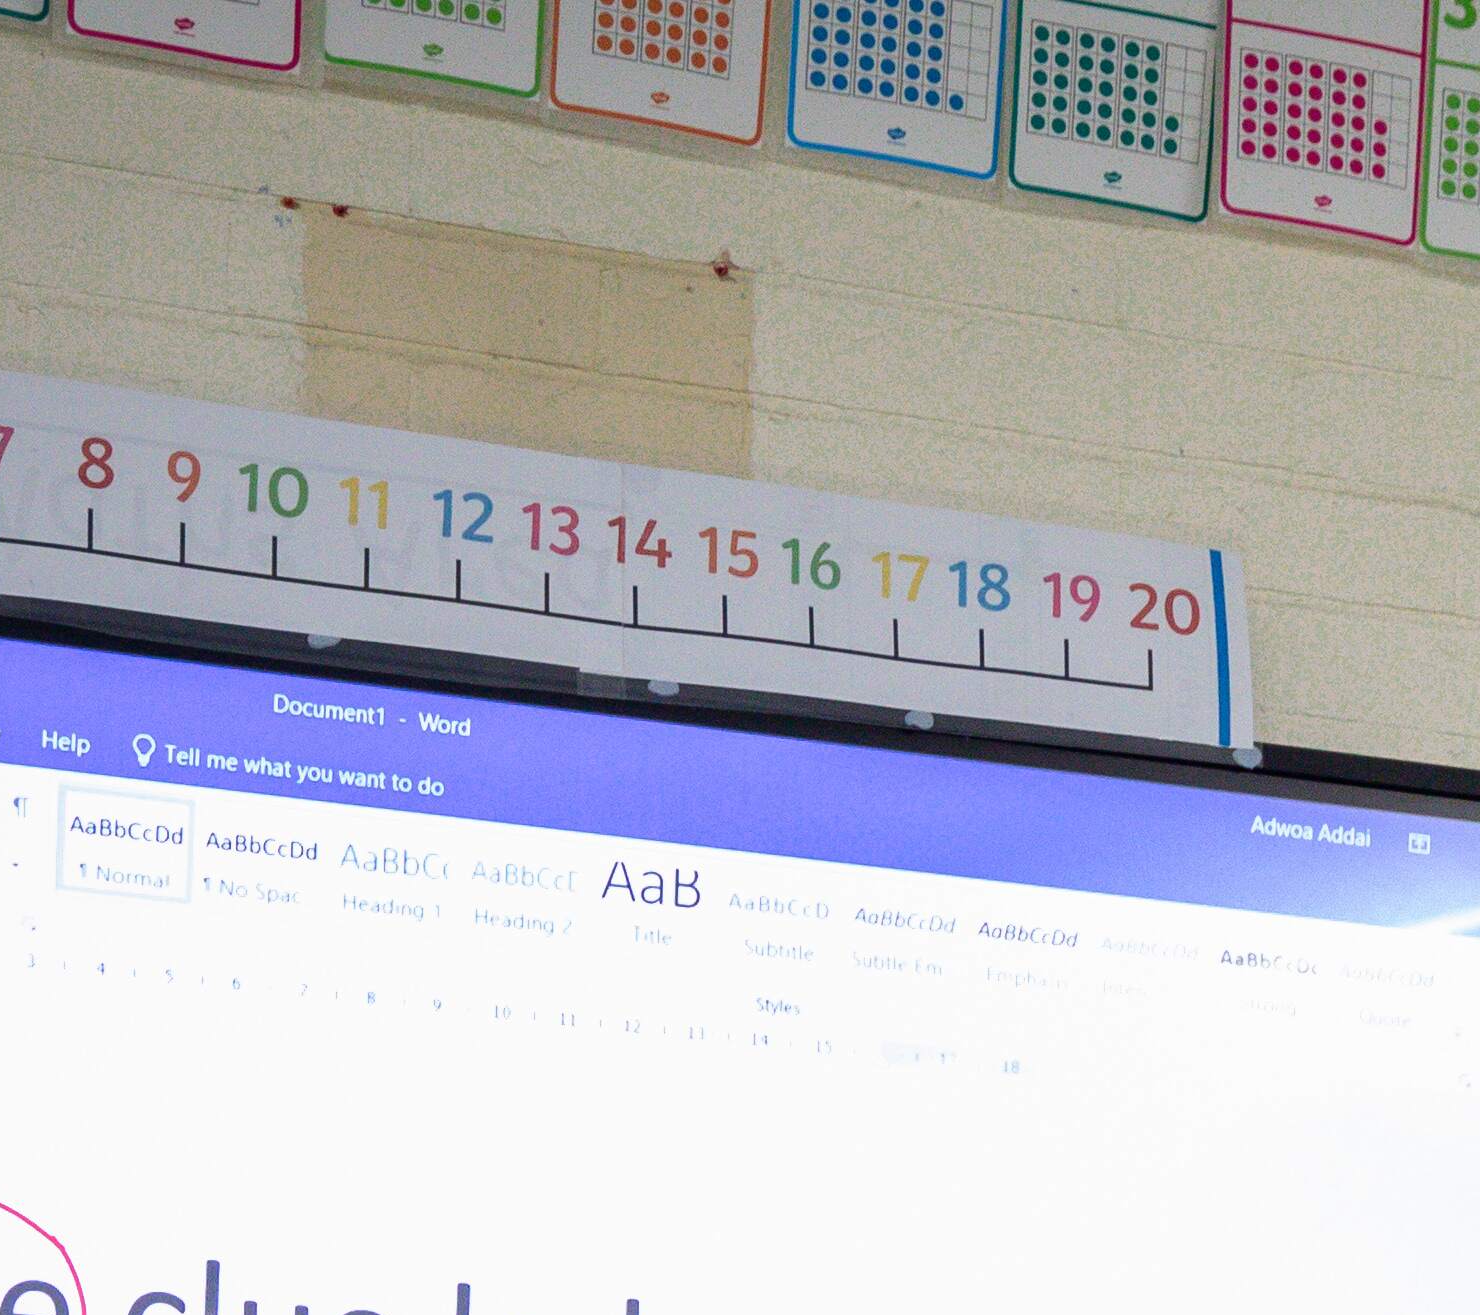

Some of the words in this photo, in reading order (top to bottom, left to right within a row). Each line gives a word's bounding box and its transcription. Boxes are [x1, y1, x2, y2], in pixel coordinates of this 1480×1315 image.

[77, 436, 115, 490] 8
[167, 450, 202, 503] 9
[238, 463, 309, 519] 10
[339, 476, 389, 530] 11
[432, 489, 494, 544] 12
[521, 502, 580, 557] 13
[607, 515, 673, 569] 14
[698, 526, 759, 579] 15
[781, 537, 841, 591] 16
[871, 551, 930, 602] 17
[948, 560, 1011, 612] 18
[1042, 572, 1101, 623] 19
[1129, 582, 1201, 636] 20
[273, 693, 385, 726] Document1
[418, 711, 472, 737] Word
[41, 729, 91, 757] Help
[164, 743, 201, 767] Tell
[206, 753, 239, 772] me
[243, 756, 292, 779] what
[296, 765, 333, 784] you
[338, 770, 386, 790] want
[391, 773, 413, 793] to
[417, 776, 445, 797] do
[1250, 815, 1314, 841] Adwoa
[1317, 823, 1371, 848] Addai
